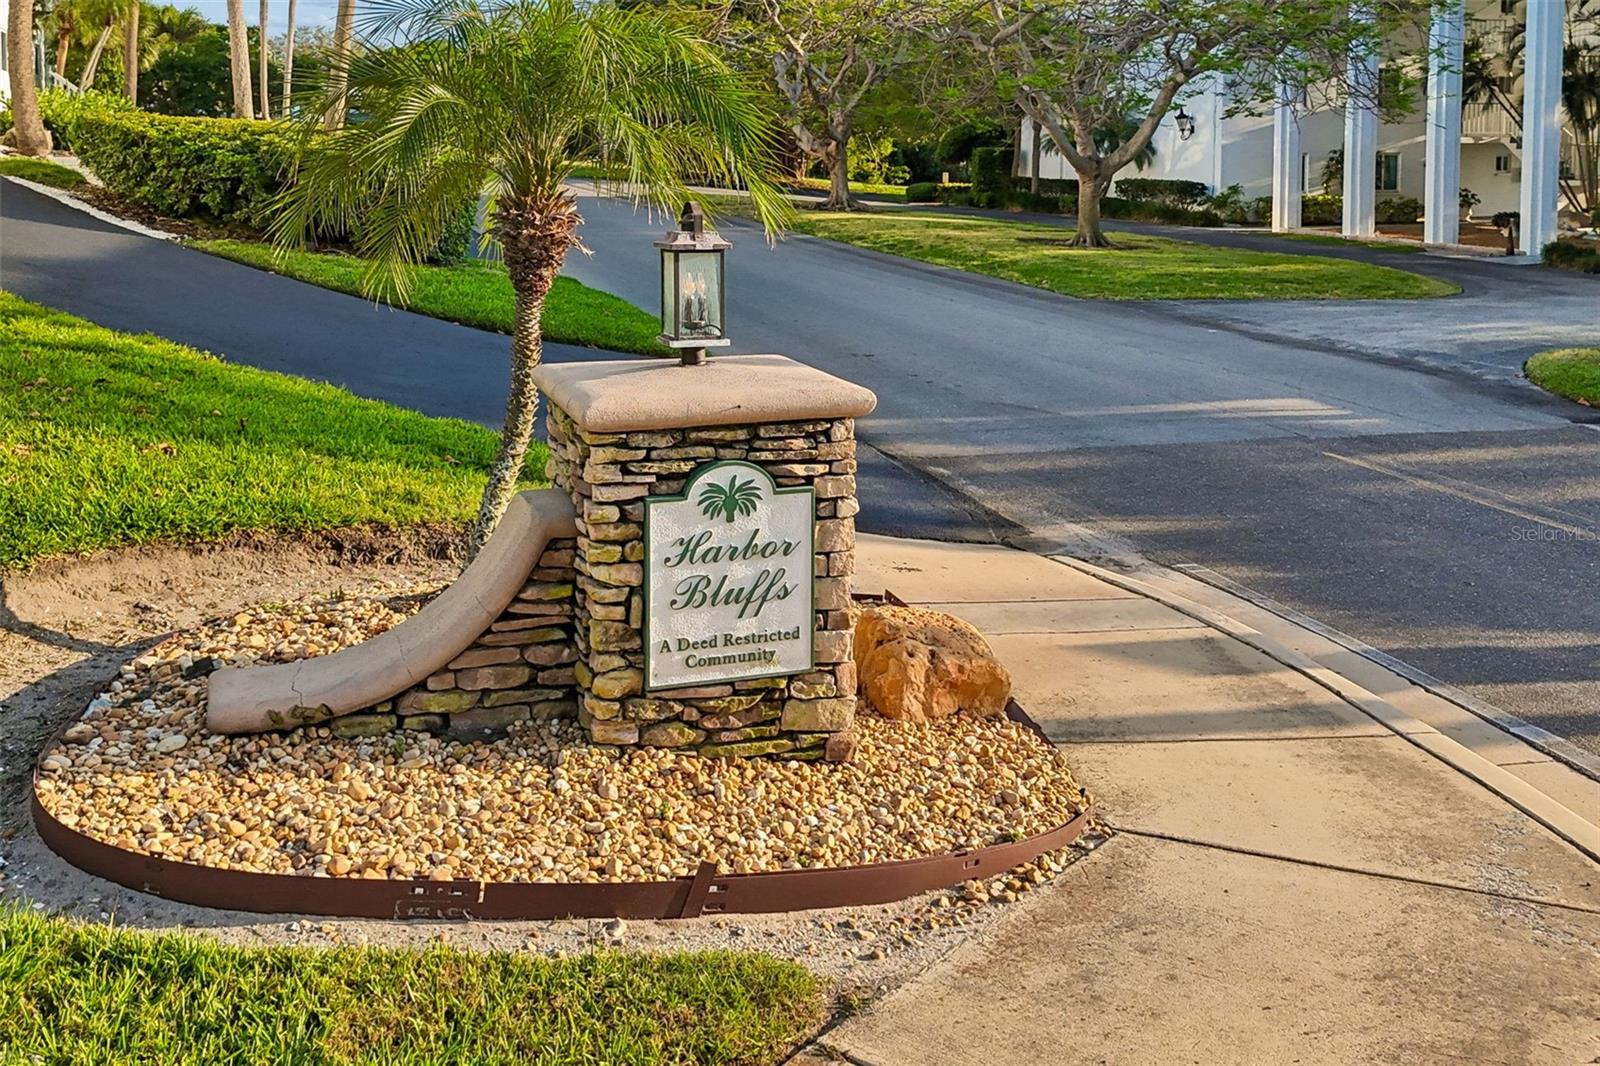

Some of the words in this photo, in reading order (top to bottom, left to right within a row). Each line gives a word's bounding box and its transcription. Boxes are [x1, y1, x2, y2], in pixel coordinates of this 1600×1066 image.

[664, 528, 802, 568] Harbor
[670, 567, 799, 619] Bluffs
[660, 640, 672, 653] A
[677, 636, 717, 651] Deed
[722, 626, 800, 647] Restricted
[685, 649, 776, 668] Community
